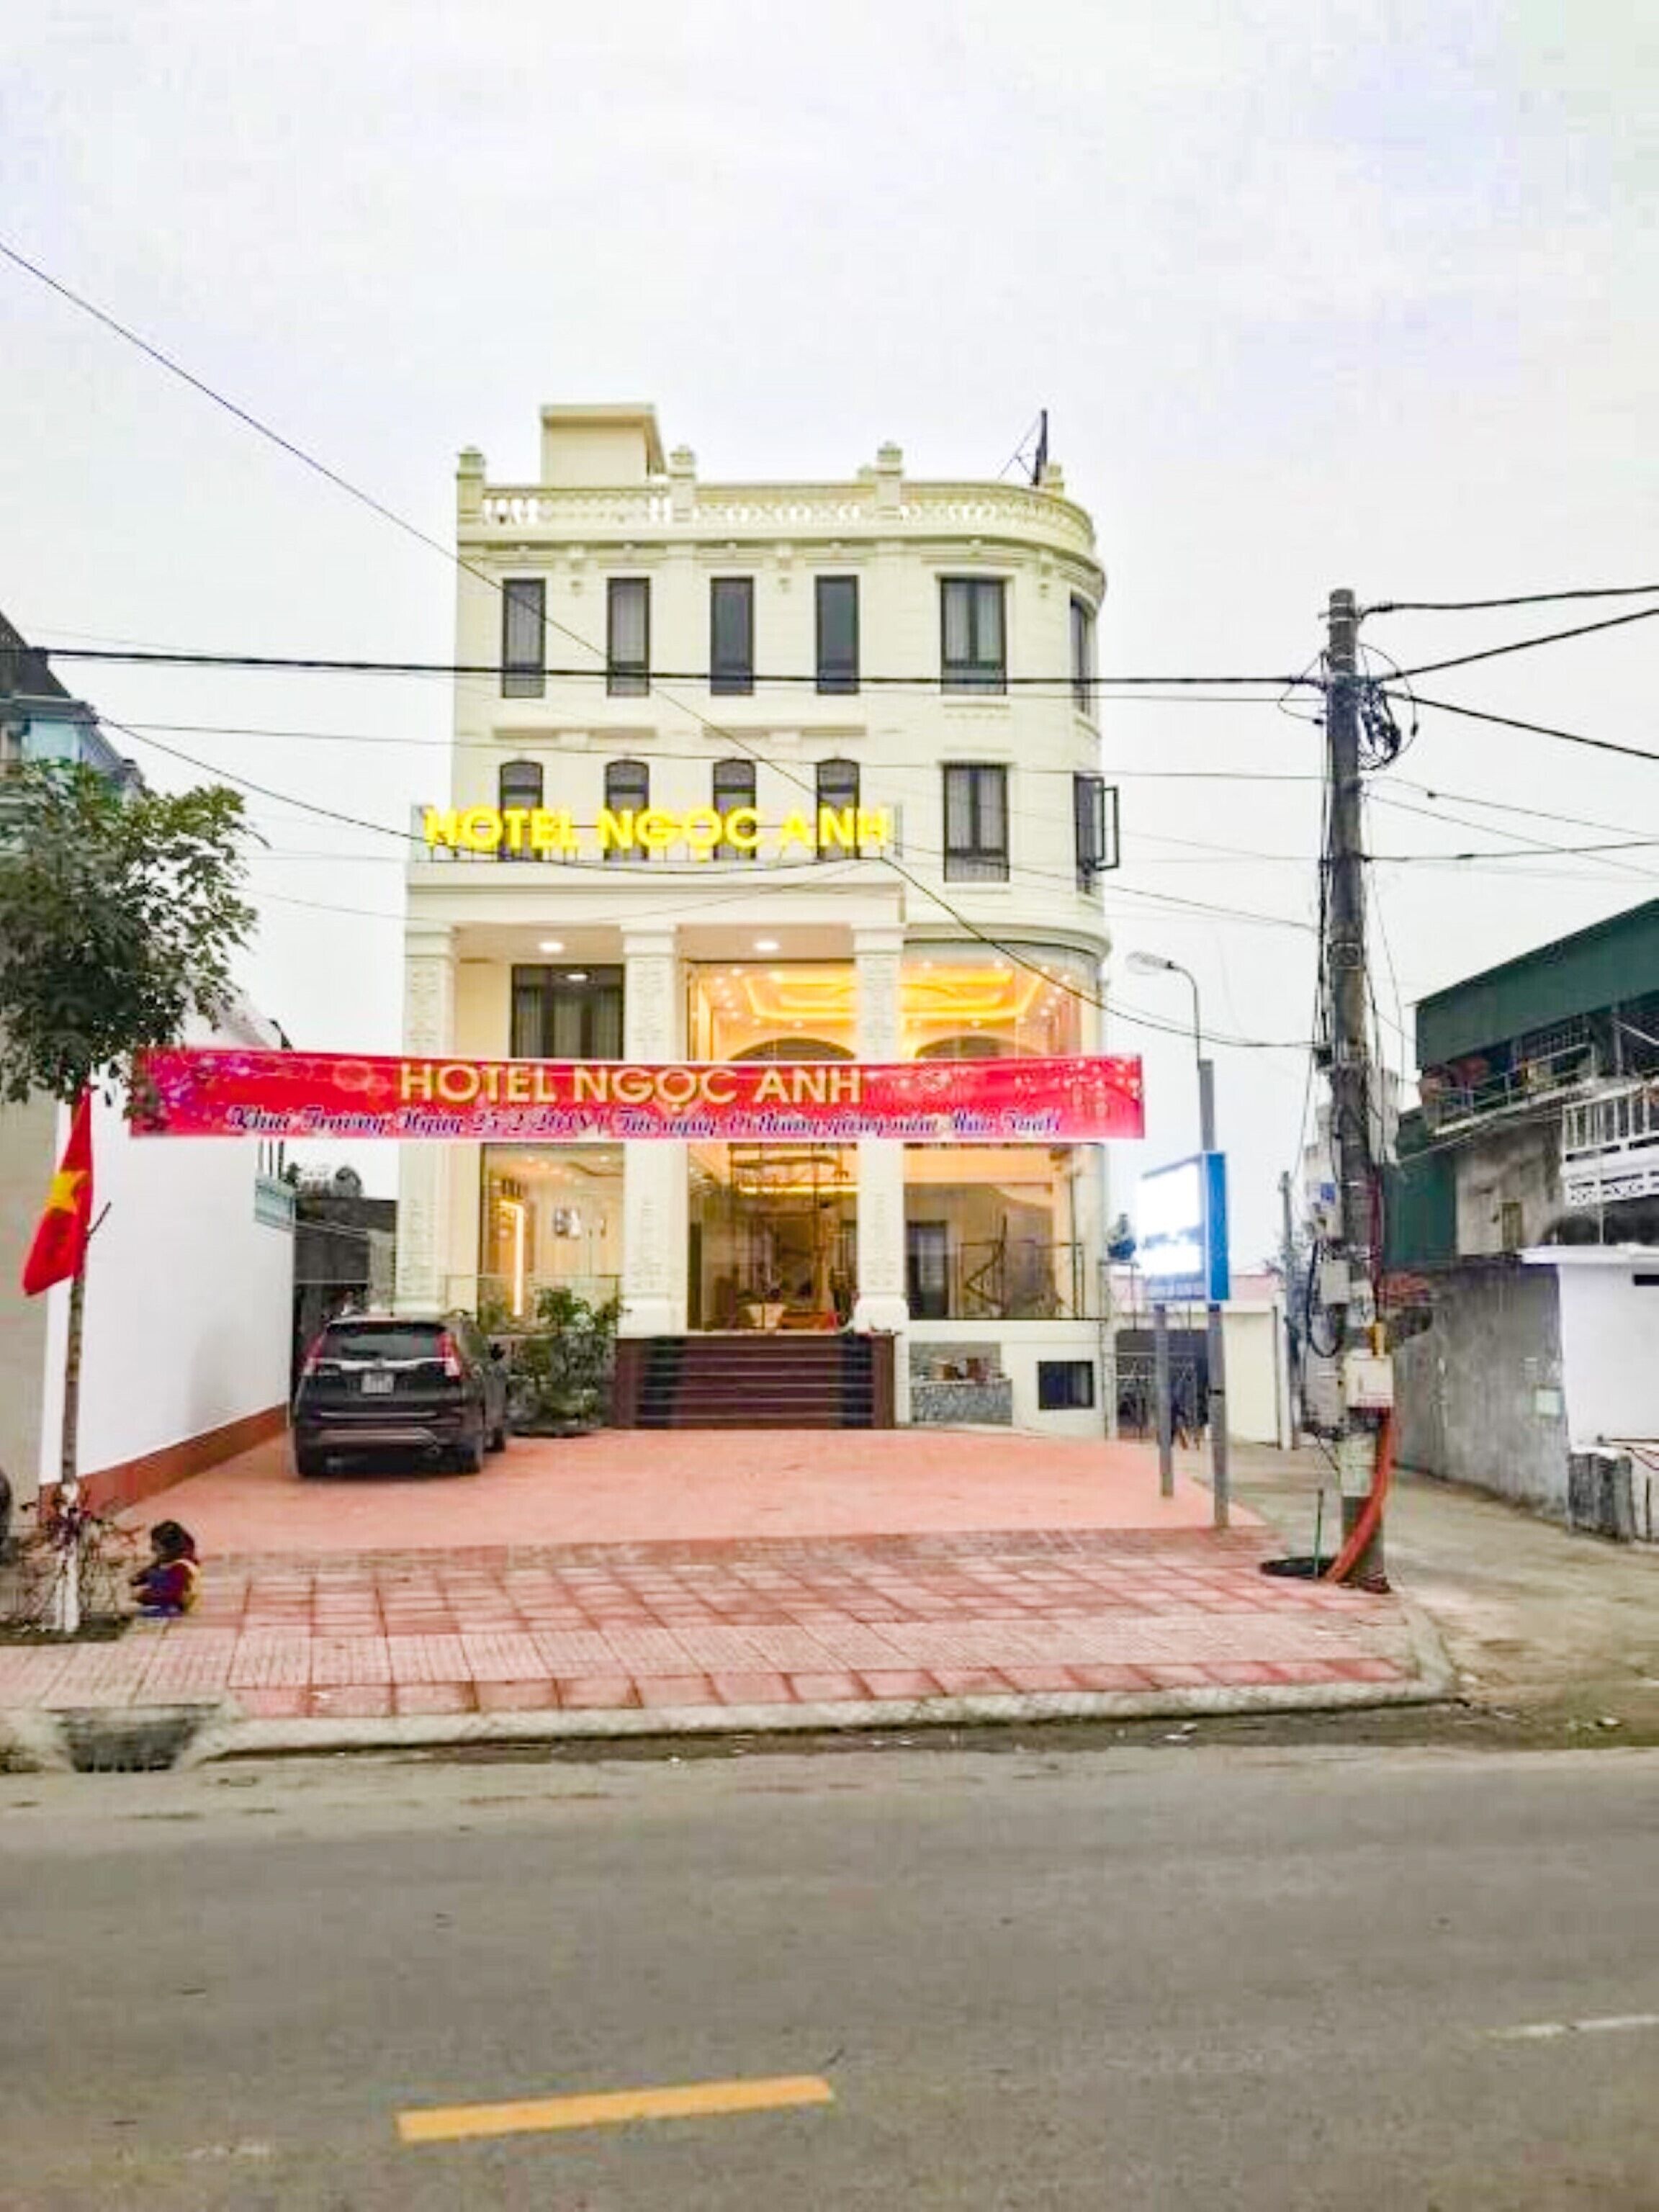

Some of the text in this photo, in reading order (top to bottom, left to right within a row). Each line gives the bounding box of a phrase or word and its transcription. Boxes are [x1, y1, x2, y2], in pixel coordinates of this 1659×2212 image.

[423, 804, 893, 861] HOTEL NGỌC ANH
[400, 1063, 862, 1113] HOTEL NGỌC ANH
